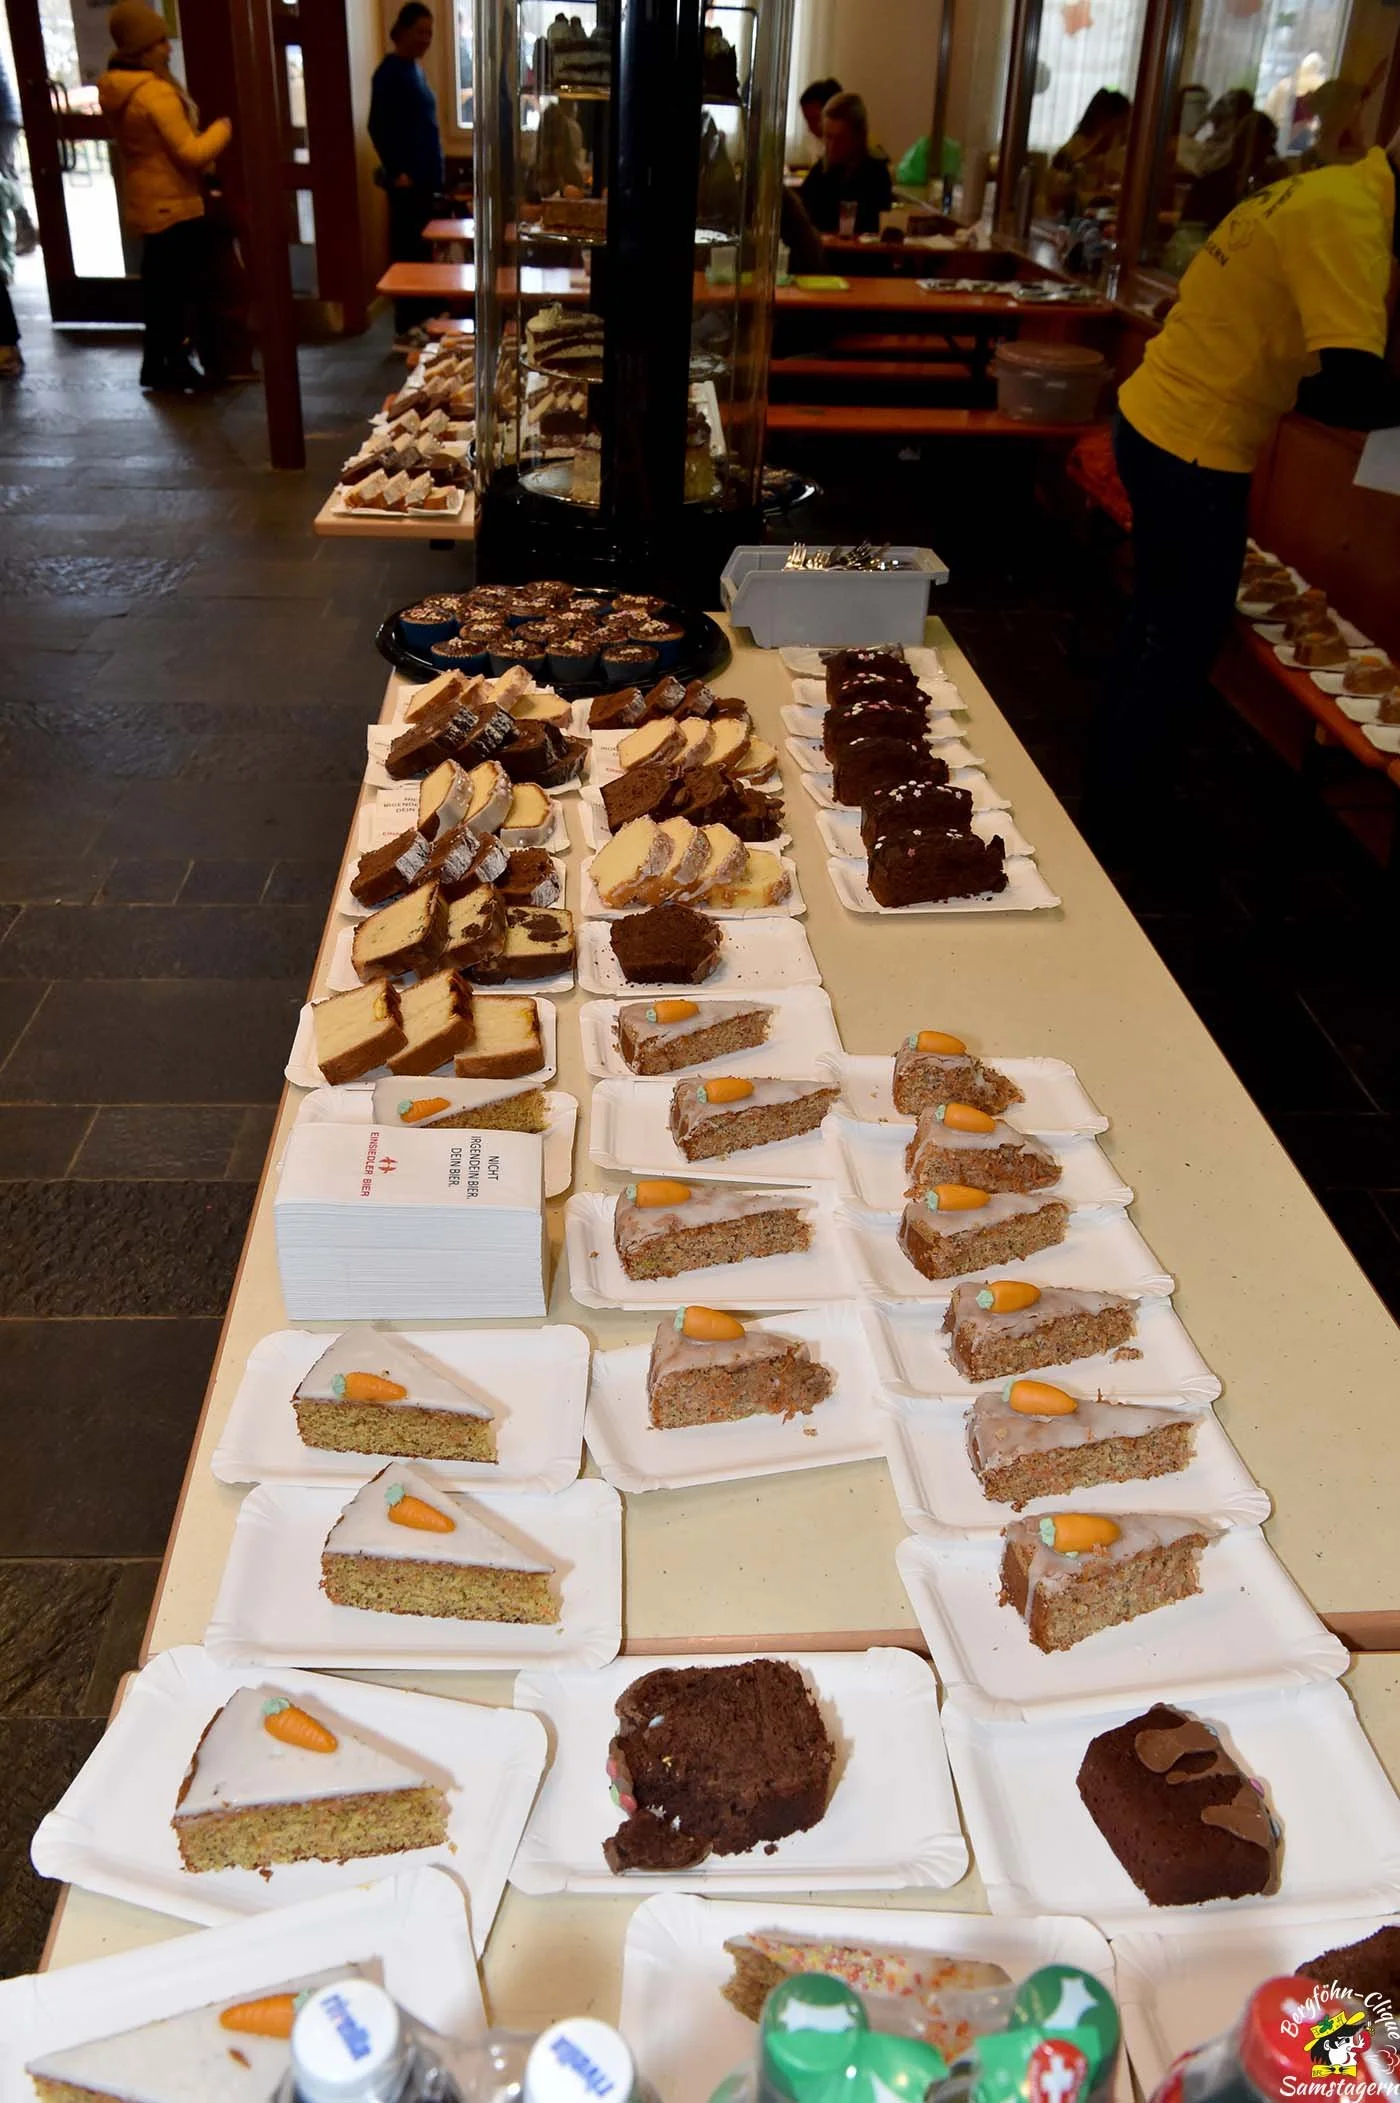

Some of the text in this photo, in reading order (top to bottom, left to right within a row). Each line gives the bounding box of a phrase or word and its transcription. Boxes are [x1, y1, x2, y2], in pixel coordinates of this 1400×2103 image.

[361, 1131, 379, 1197] EINSIEDLER BIER
[450, 1147, 462, 1167] DEIN
[468, 1135, 482, 1179] IRGENDEIN
[488, 1155, 500, 1181] NICHT
